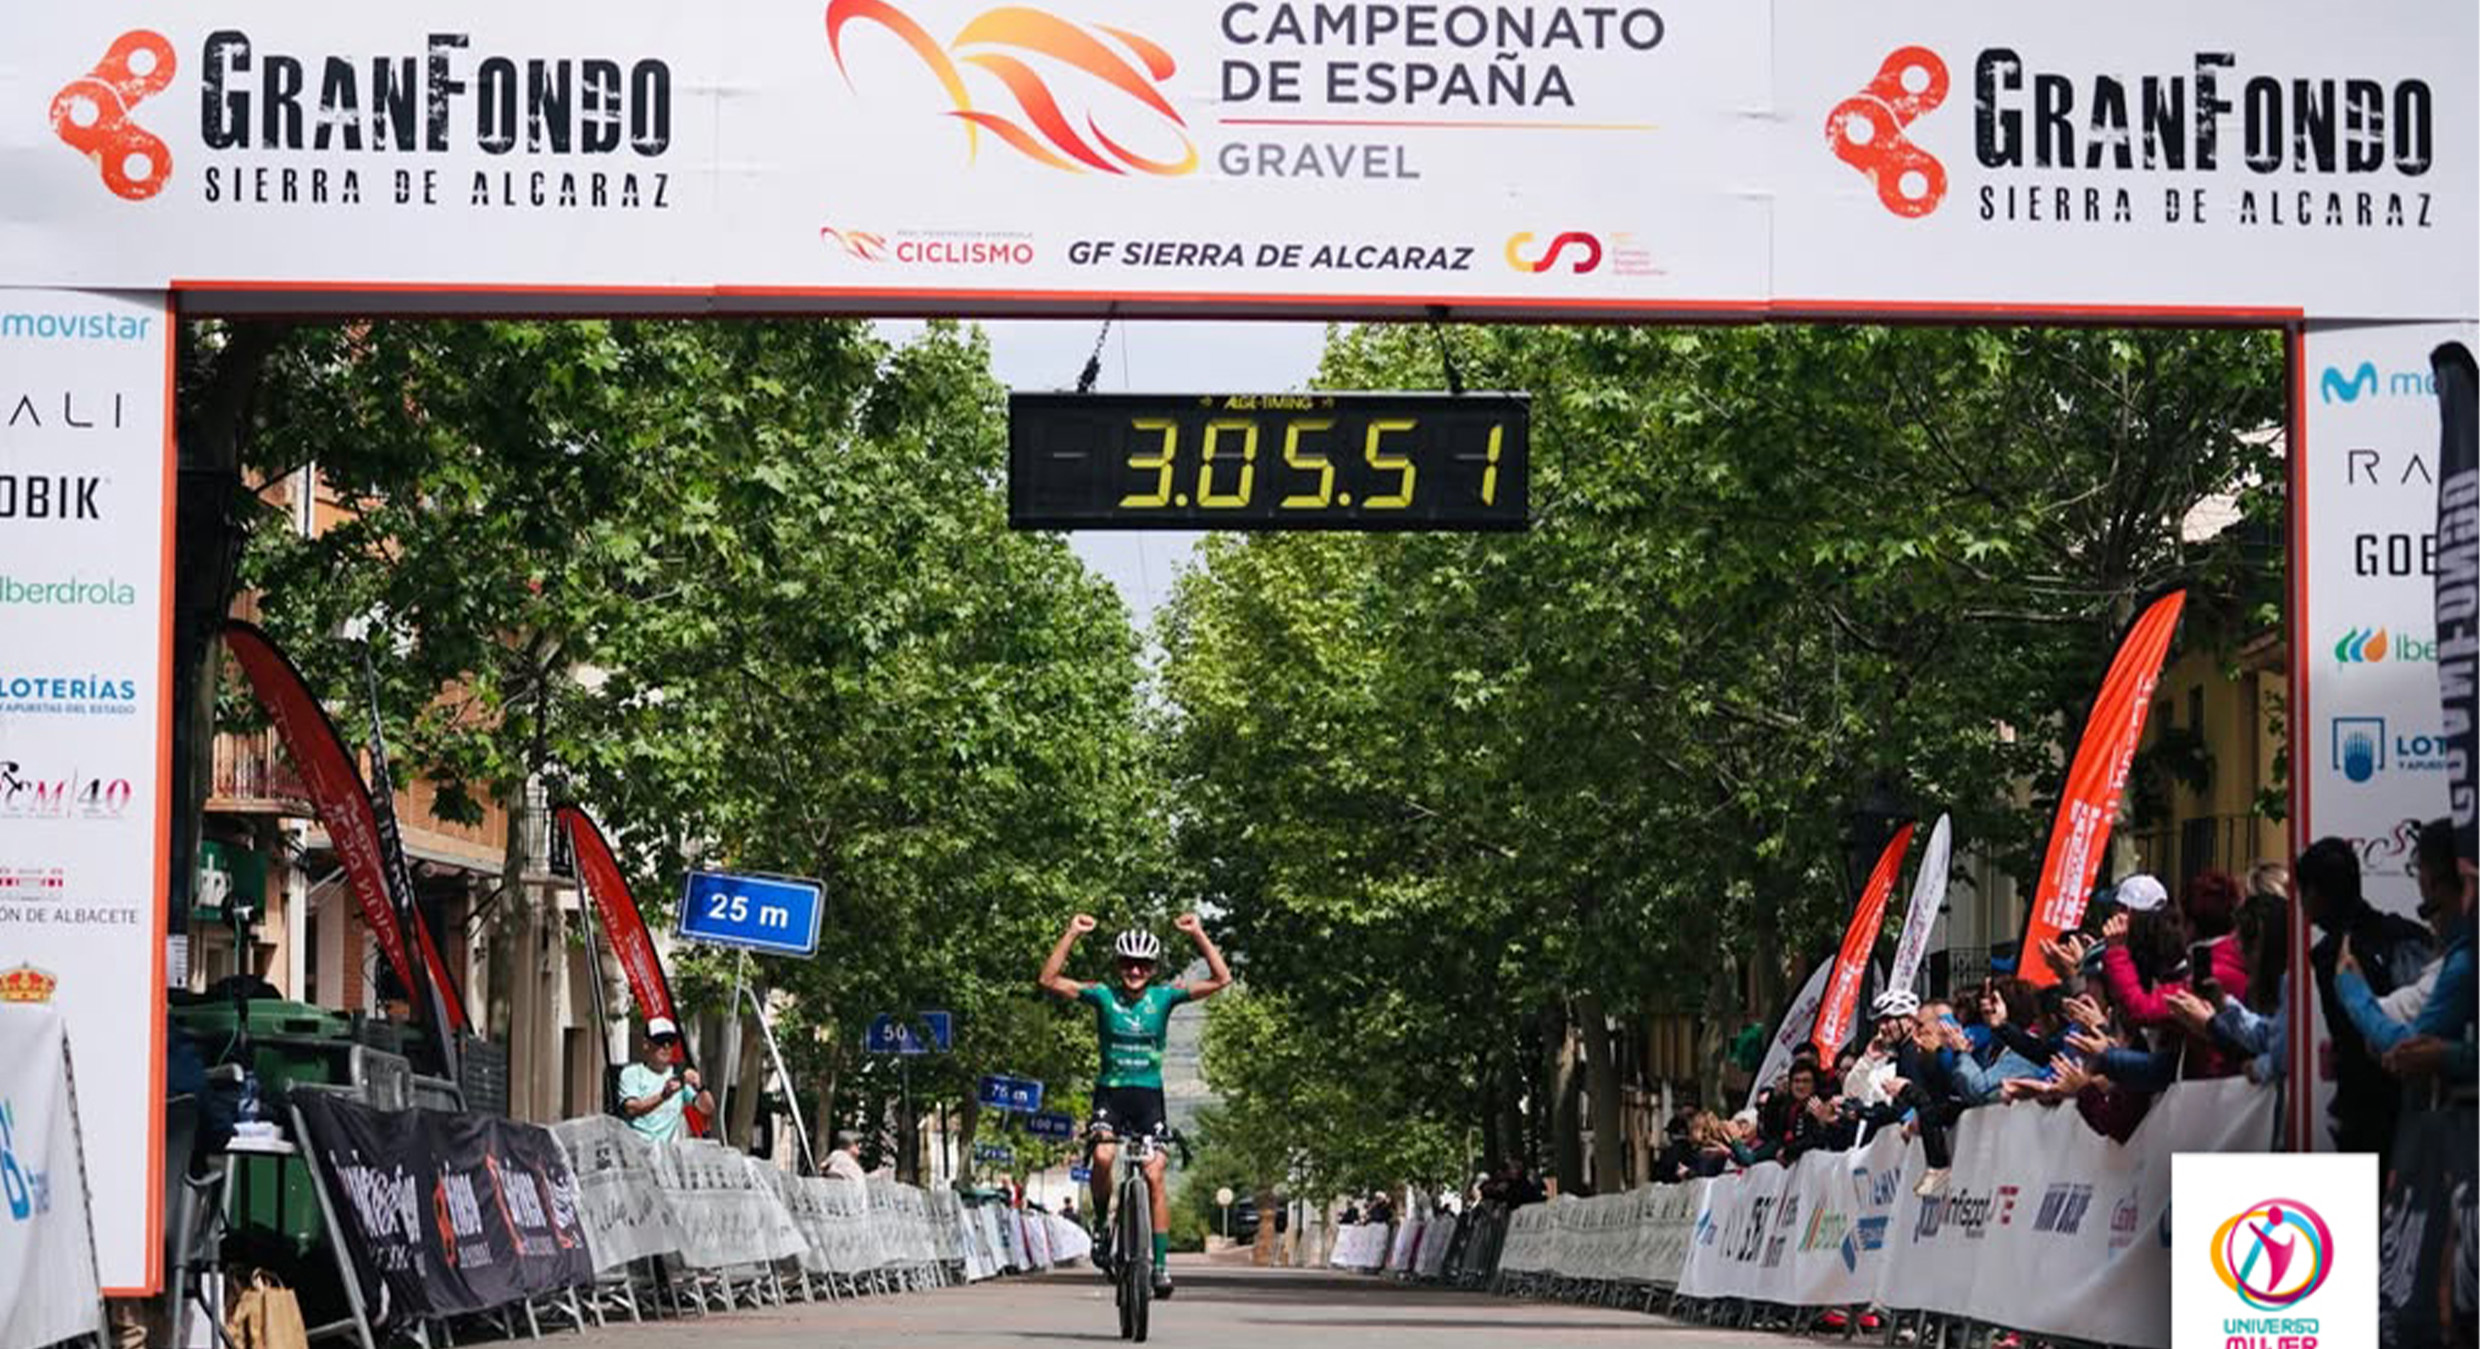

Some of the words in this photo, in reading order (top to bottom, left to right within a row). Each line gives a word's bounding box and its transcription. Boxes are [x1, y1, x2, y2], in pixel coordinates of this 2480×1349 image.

[1221, 2, 1665, 51] CAMPEONATO
[1222, 60, 1301, 102] DE
[1326, 51, 1576, 107] ESPAÑA
[1218, 142, 1420, 179] GRAVEL
[206, 167, 359, 203] SIERRA
[395, 170, 436, 204] DE
[472, 171, 668, 207] ALCARAZ
[1980, 185, 2131, 222] SIERRA
[2166, 189, 2205, 223] DE
[2241, 190, 2430, 227] ALCARAZ
[897, 242, 1034, 264] CICLISMO
[1069, 241, 1115, 264] GF
[1122, 242, 1243, 267] SIERRA
[1256, 244, 1302, 267] DE
[1310, 245, 1474, 270] ALCARAZ
[2, 313, 150, 339] movistar
[708, 893, 748, 923] 25
[759, 905, 788, 929] m
[882, 1023, 908, 1042] 50
